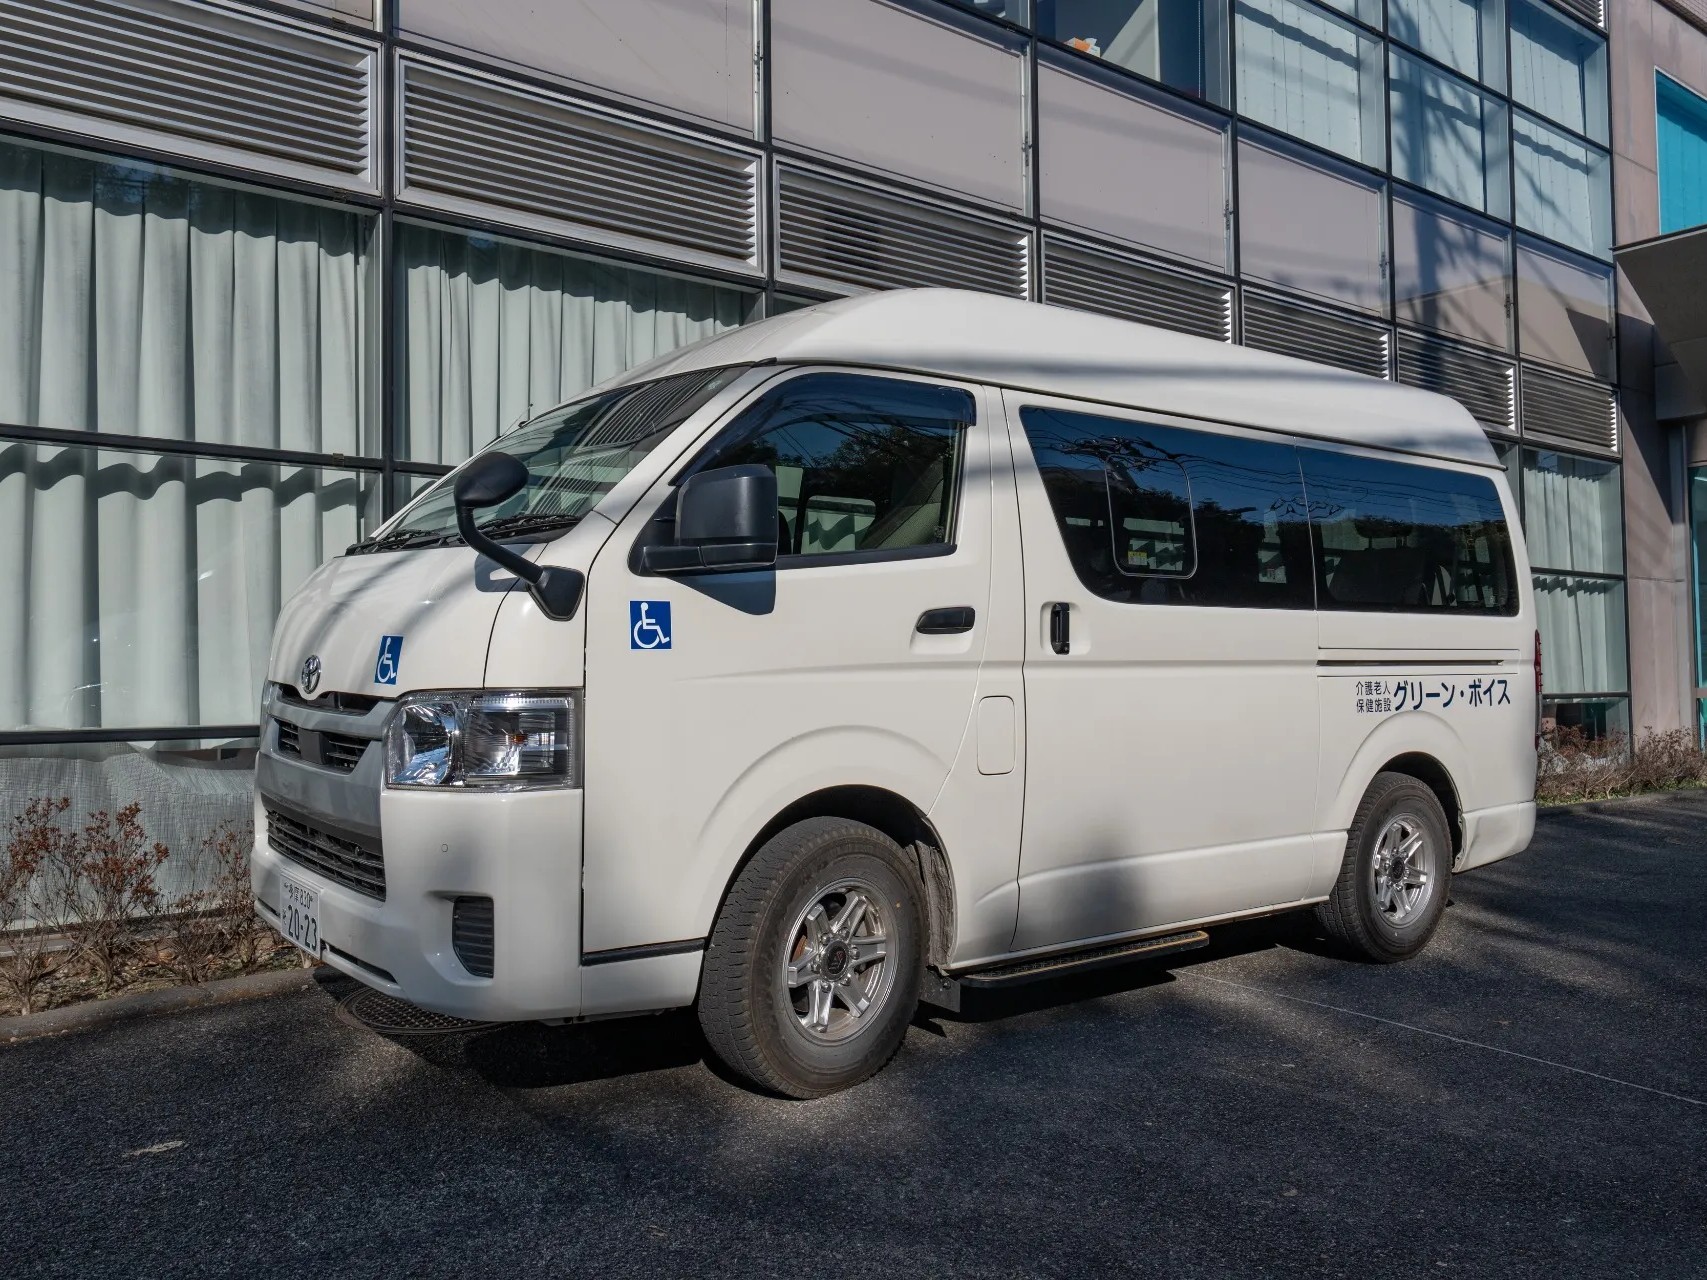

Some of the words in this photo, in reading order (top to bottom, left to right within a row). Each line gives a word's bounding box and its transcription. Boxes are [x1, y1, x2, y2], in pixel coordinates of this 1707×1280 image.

[1355, 680, 1391, 696] 介護老人
[1393, 678, 1511, 711] グリーン・ボイス
[1356, 698, 1392, 713] 保健施設
[288, 904, 317, 952] 20-23
